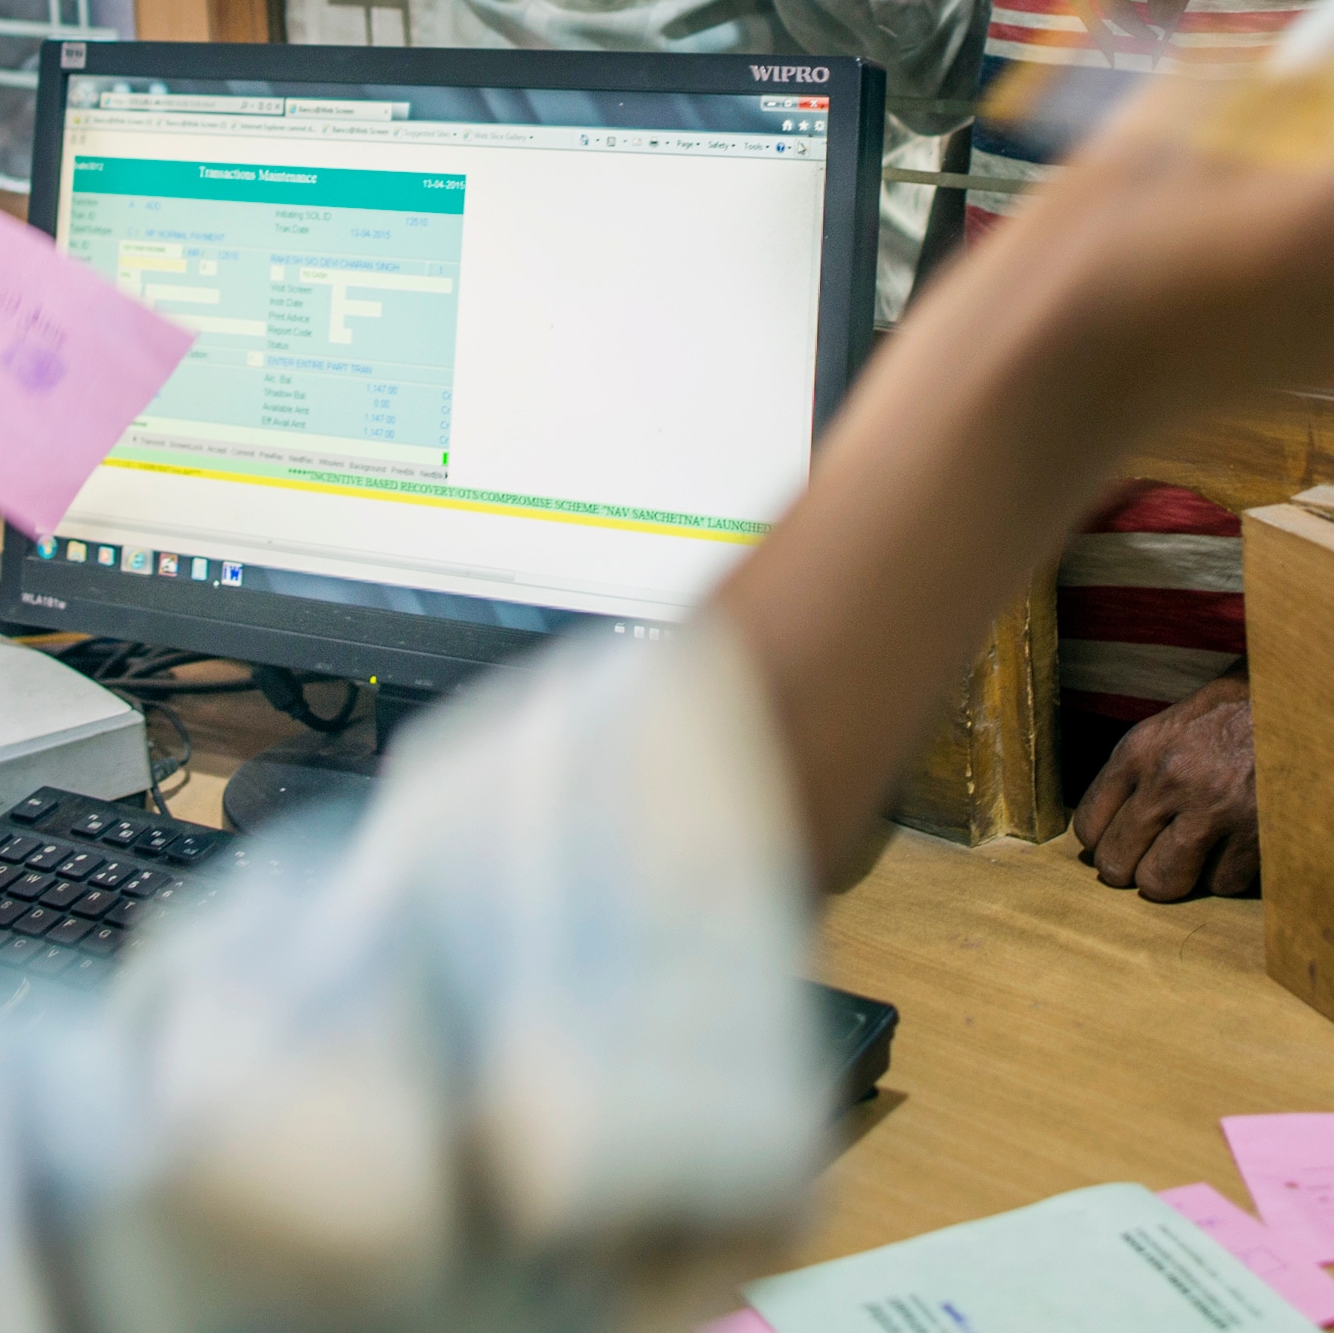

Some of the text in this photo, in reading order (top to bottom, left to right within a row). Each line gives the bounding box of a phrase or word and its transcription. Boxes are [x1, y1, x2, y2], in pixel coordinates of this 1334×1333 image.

[749, 64, 831, 84] WIPRO
[676, 139, 693, 150] Page
[708, 140, 728, 151] Safety
[744, 141, 763, 150] Tools
[199, 166, 318, 184] Transactions Maintenance
[423, 179, 466, 190] 13-04-2015
[275, 210, 304, 220] Initiating
[306, 211, 321, 221] SOL
[375, 262, 400, 272] SINGH
[286, 285, 312, 295] Screen
[267, 325, 312, 338] Report Code
[267, 341, 289, 351] Status
[268, 356, 372, 375] ENTER ENTIRE PART TRAN
[264, 388, 293, 399] Shadow
[262, 403, 294, 414] Available
[295, 406, 309, 416] Amt
[349, 460, 387, 474] Background
[365, 476, 398, 492] BASED
[554, 499, 600, 516] SCHEME
[706, 516, 773, 535] LAUNCHED
[26, 874, 42, 883] W
[56, 883, 70, 892] E
[88, 891, 101, 901] R
[31, 909, 44, 918] D
